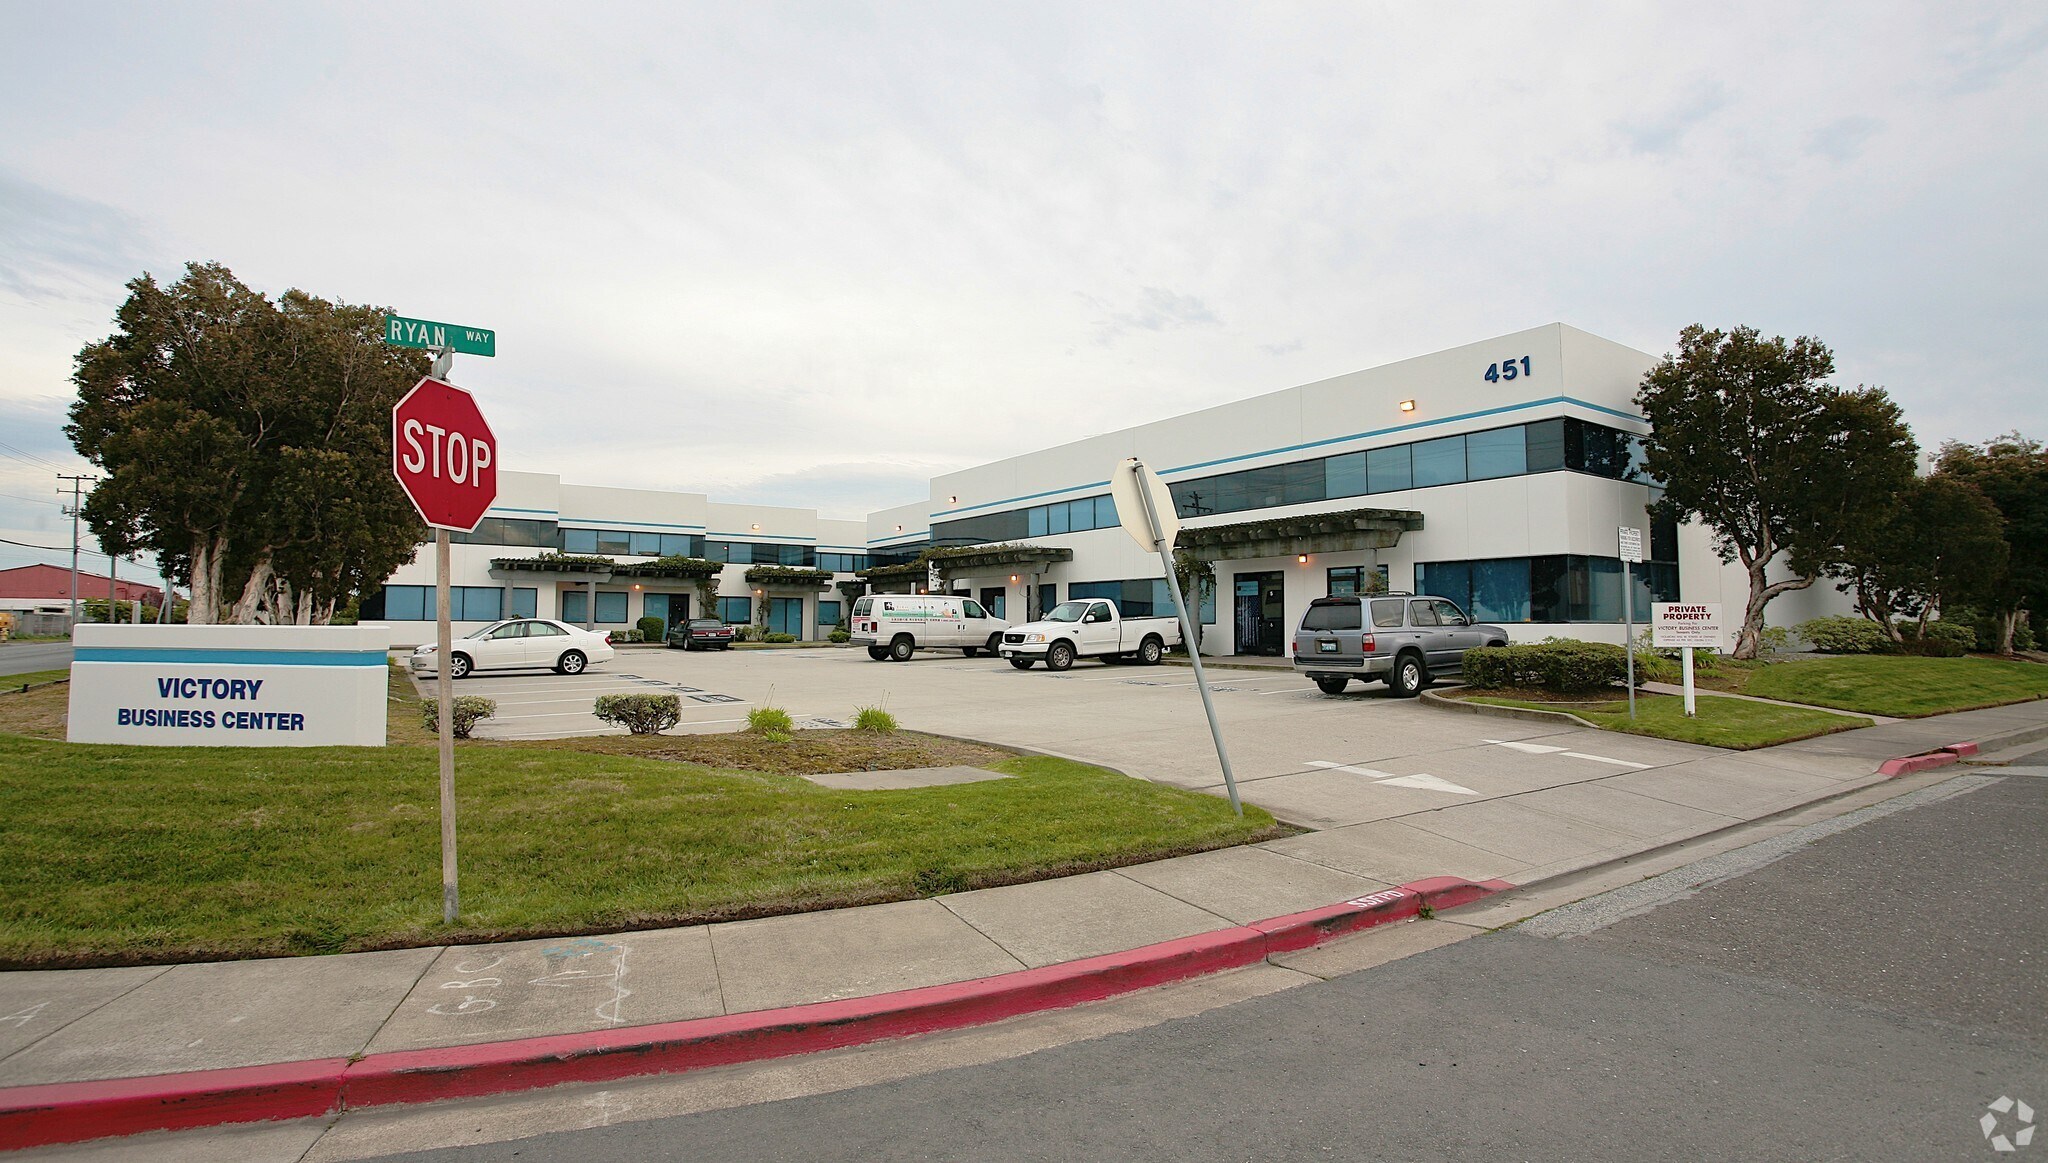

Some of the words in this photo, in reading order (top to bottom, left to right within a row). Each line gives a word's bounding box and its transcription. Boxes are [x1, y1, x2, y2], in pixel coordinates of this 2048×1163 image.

[391, 319, 446, 347] RYAN
[465, 330, 490, 344] WAY
[1484, 355, 1531, 384] 451
[402, 418, 492, 488] STOP
[157, 677, 264, 701] VICTORY
[117, 708, 216, 729] BUSINESS
[222, 711, 305, 731] CENTER
